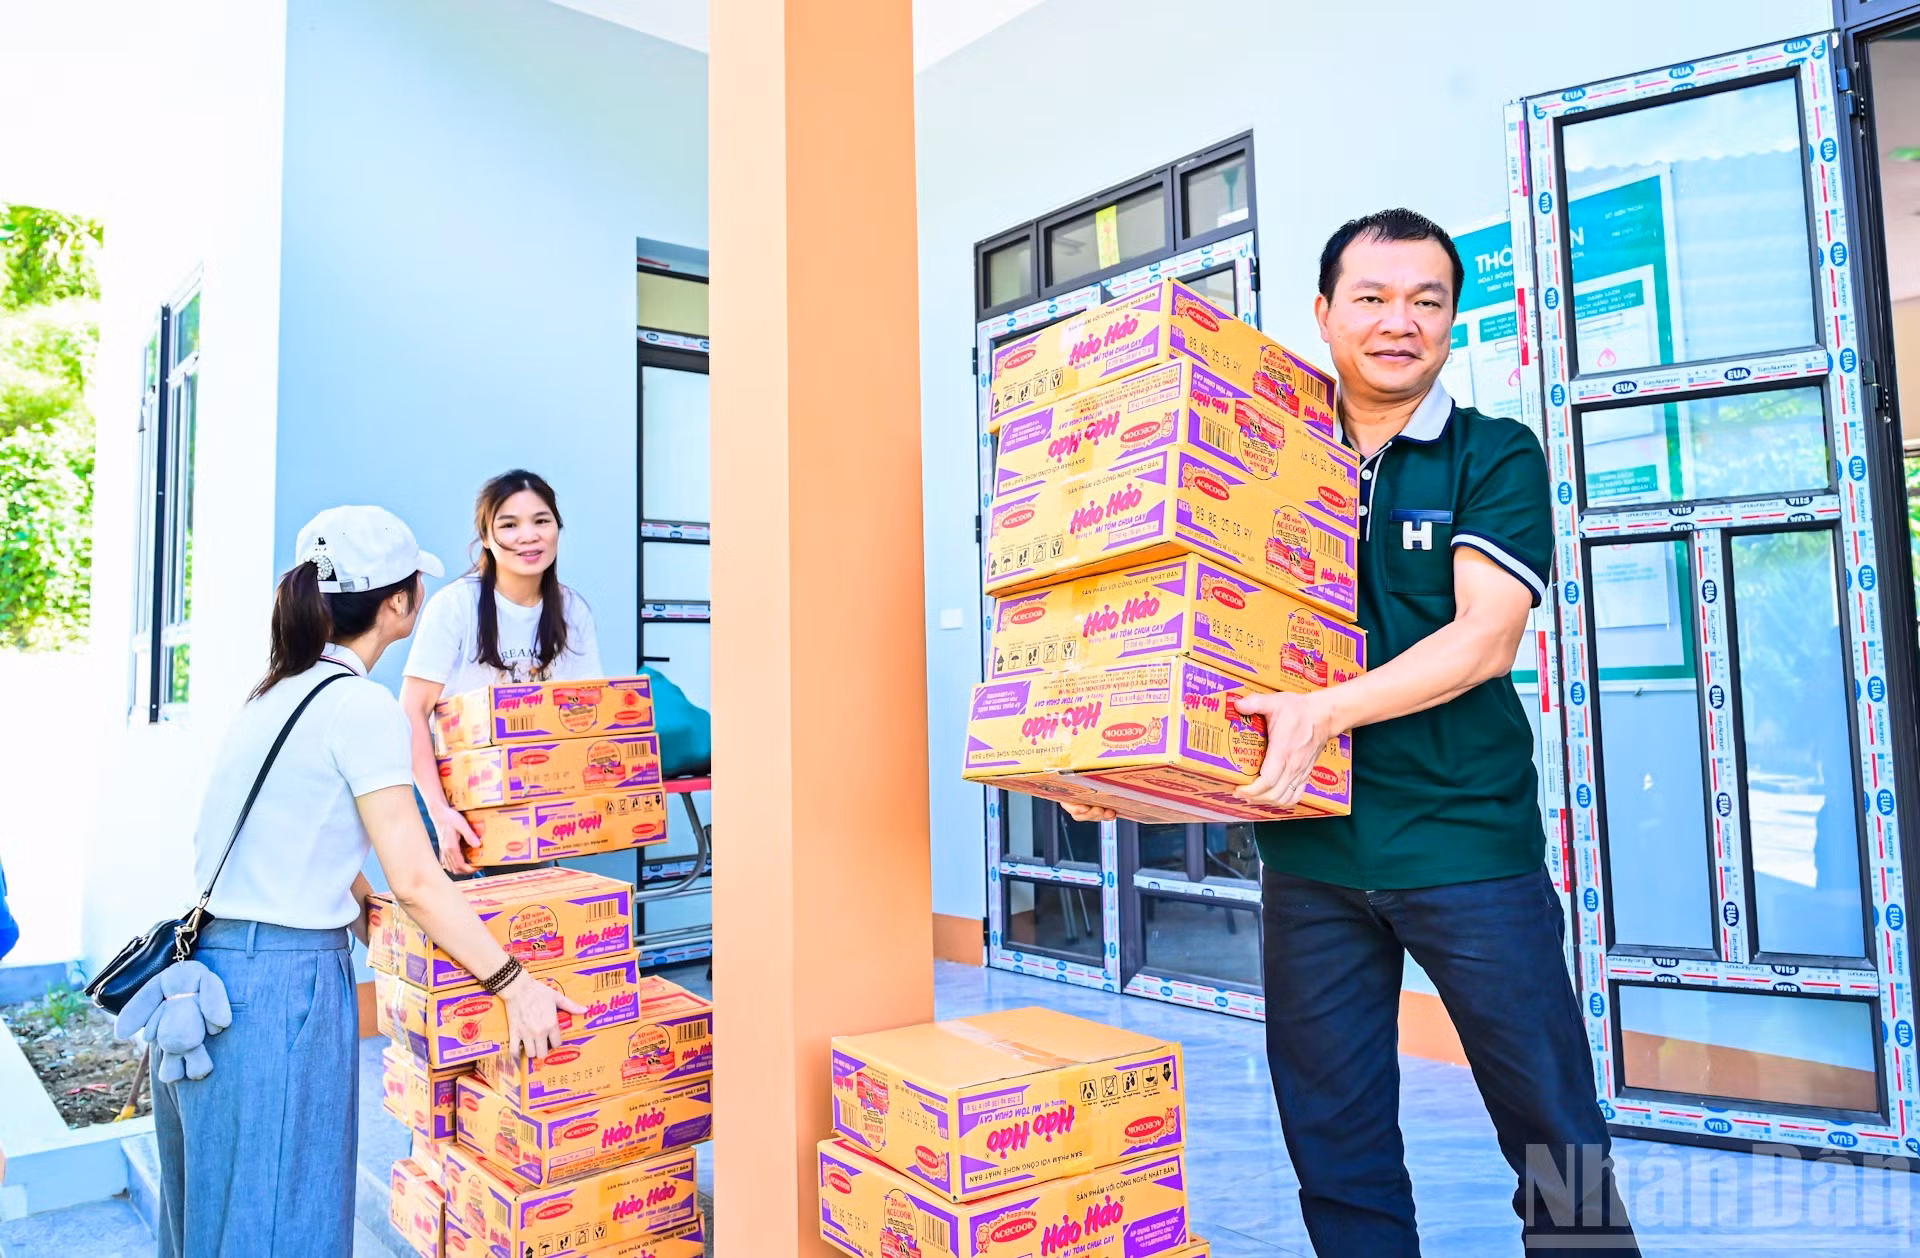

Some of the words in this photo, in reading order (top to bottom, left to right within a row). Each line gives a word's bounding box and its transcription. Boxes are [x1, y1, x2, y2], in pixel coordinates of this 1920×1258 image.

[1787, 39, 1809, 52] EUA
[1672, 66, 1693, 77] EUA
[1824, 141, 1834, 160] EUA
[1474, 243, 1513, 274] THÔ
[1834, 245, 1844, 264] EUA
[1548, 290, 1556, 307] EUA
[1843, 351, 1854, 370] EUA
[1727, 369, 1749, 379] EUA
[1553, 387, 1563, 404] EUA
[1615, 382, 1635, 393] EUA
[1852, 458, 1863, 479] EUA
[1861, 568, 1873, 588] EUA
[1704, 581, 1715, 602] EUA
[1711, 687, 1722, 707] EUA
[1871, 679, 1882, 698] EUA
[1580, 787, 1589, 805] EUA
[1718, 795, 1730, 815] EUA
[1880, 793, 1891, 813] EUA
[1726, 904, 1737, 924] EUA
[1889, 907, 1900, 928] EUA
[1898, 1023, 1910, 1045] EUA
[1707, 1120, 1729, 1132] EUA
[1831, 1134, 1855, 1147] EUA
[1115, 1178, 1132, 1190] CÔNG
[993, 1221, 1035, 1240] ACECOOK
[1041, 1214, 1082, 1256] Hảo
[1084, 1195, 1123, 1235] Hảo
